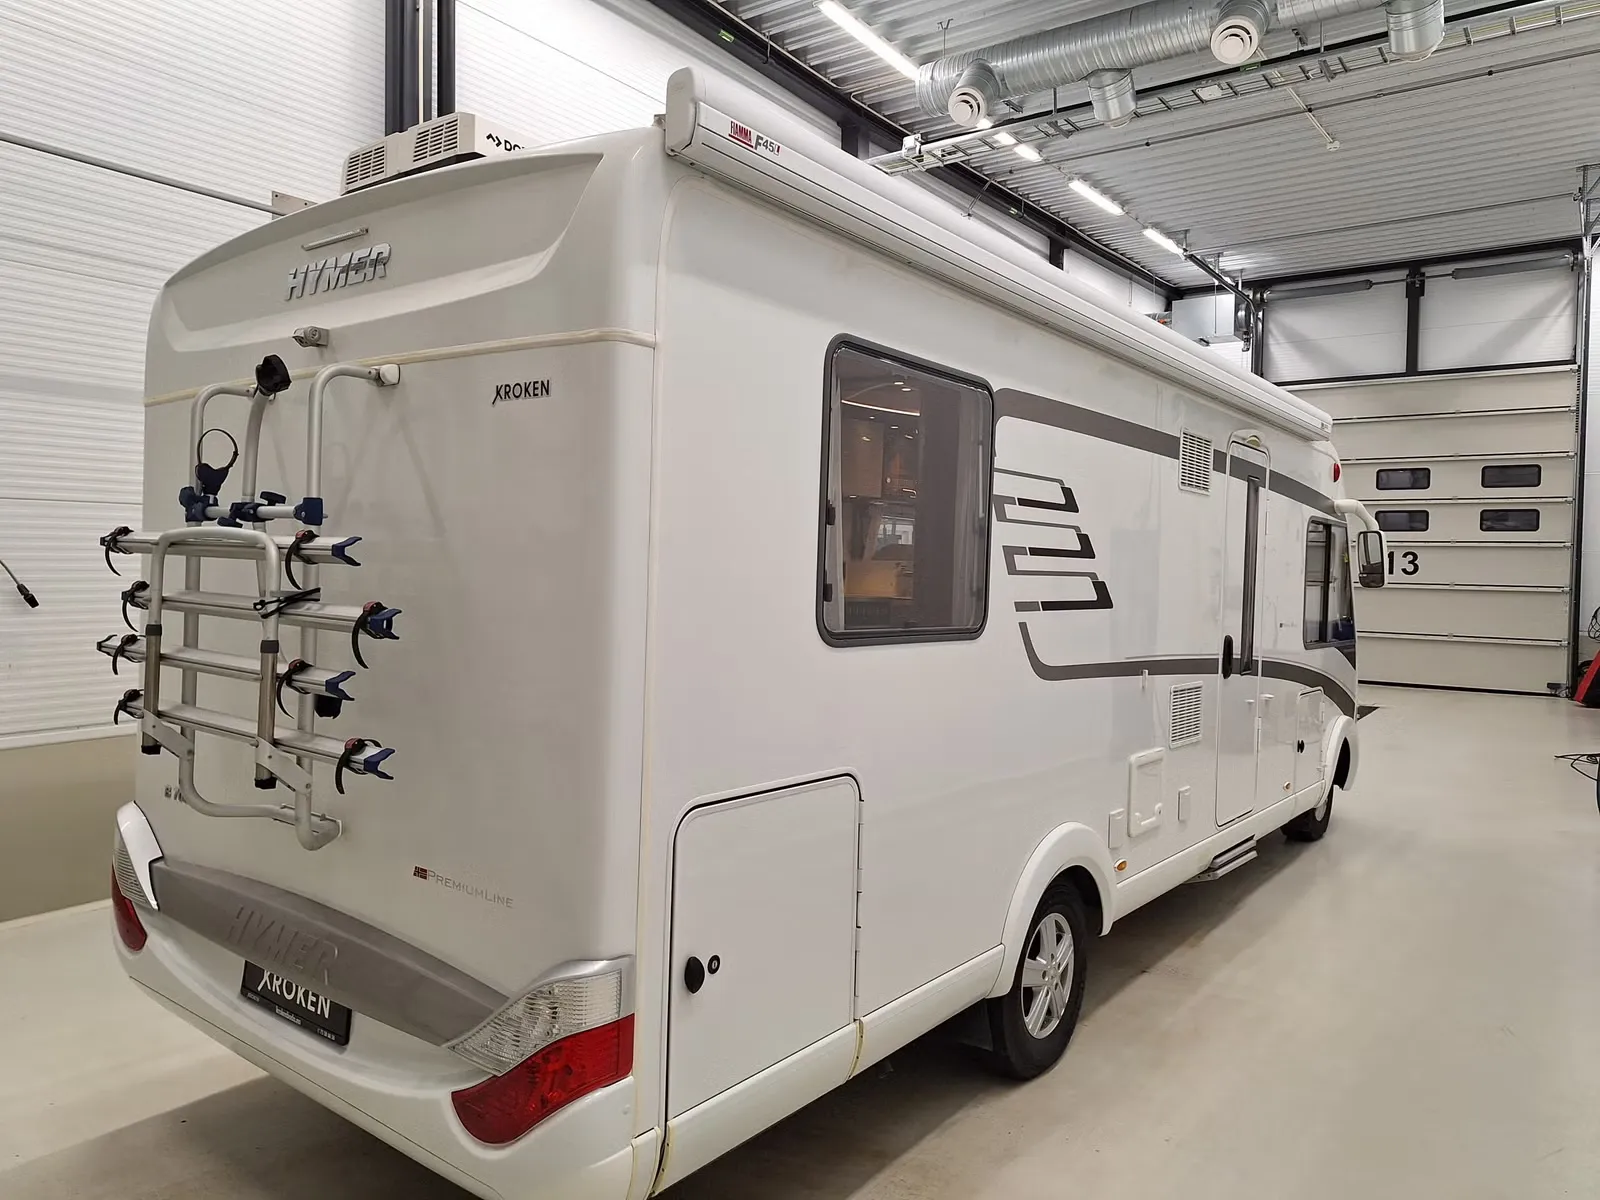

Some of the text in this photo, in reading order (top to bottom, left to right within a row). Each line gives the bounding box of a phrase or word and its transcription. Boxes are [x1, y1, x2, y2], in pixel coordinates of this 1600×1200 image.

[730, 120, 753, 144] FIAMMA
[285, 242, 392, 302] HYMER
[491, 379, 550, 405] KROKEN
[1387, 550, 1420, 576] 13
[225, 904, 339, 986] HYMER
[257, 969, 331, 1019] KROKEN
